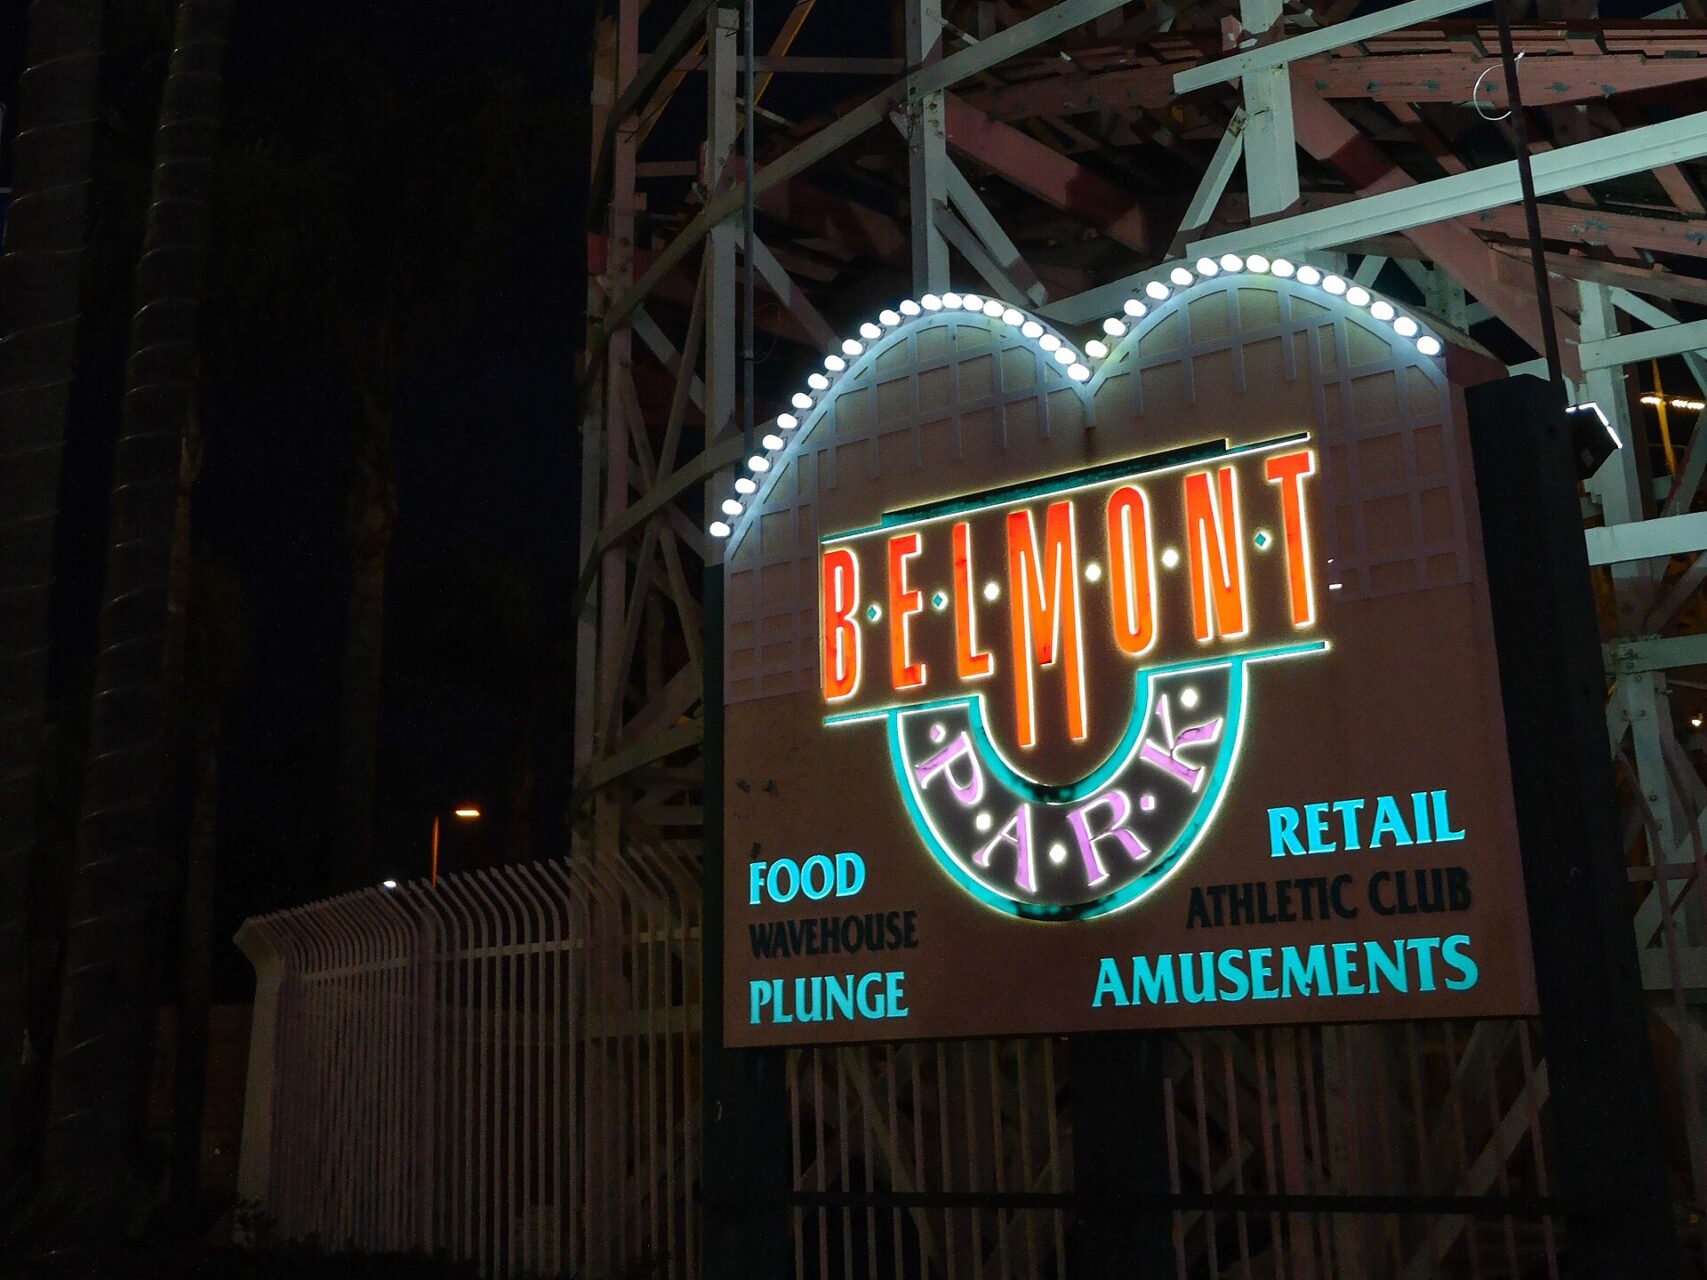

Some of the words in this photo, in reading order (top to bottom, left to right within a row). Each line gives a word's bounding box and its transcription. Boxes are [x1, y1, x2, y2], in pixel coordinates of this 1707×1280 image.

[914, 693, 1223, 893] PARK
[1267, 789, 1466, 858] RETAIL
[748, 851, 867, 905] FOOD
[1186, 874, 1358, 929] ATHLETIC
[1368, 867, 1473, 915] CLUB
[748, 910, 919, 959] WAVEHOUSE
[748, 971, 910, 1024] PLUNGE
[1091, 934, 1480, 1008] AMUSEMENTS
